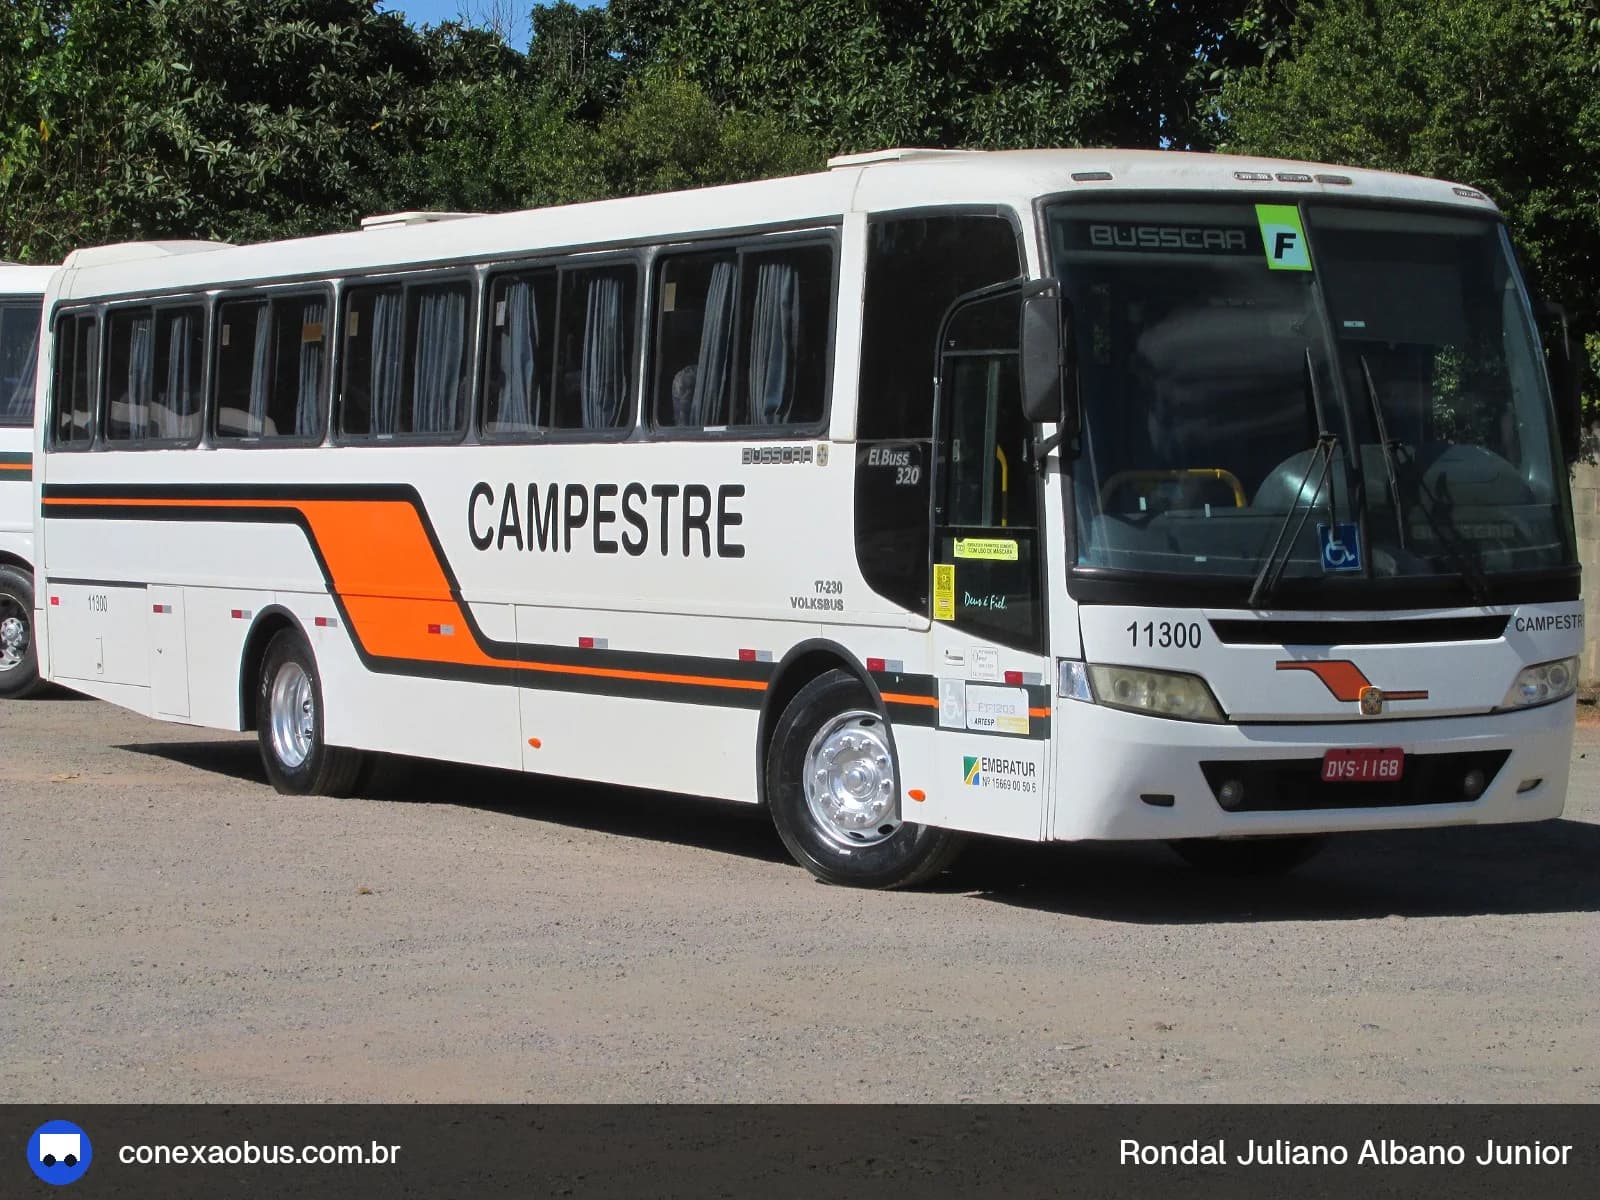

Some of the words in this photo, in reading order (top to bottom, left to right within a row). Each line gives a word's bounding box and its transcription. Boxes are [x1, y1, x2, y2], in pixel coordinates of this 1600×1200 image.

[1090, 225, 1246, 250] BUSSCAR
[1274, 232, 1297, 260] F
[742, 447, 813, 465] BUSSCAR
[895, 467, 920, 485] 320
[468, 482, 745, 558] CAMPESTRE
[814, 581, 843, 594] 17-230
[88, 595, 108, 612] 11300
[791, 597, 844, 611] VOLKSBUS
[964, 591, 982, 607] Deus
[1127, 621, 1202, 649] 11300
[974, 717, 995, 726] ARTESP
[982, 757, 1036, 776] EMBRATUR
[992, 778, 1011, 790] 15669
[1012, 780, 1021, 791] 00
[1022, 782, 1031, 792] 50
